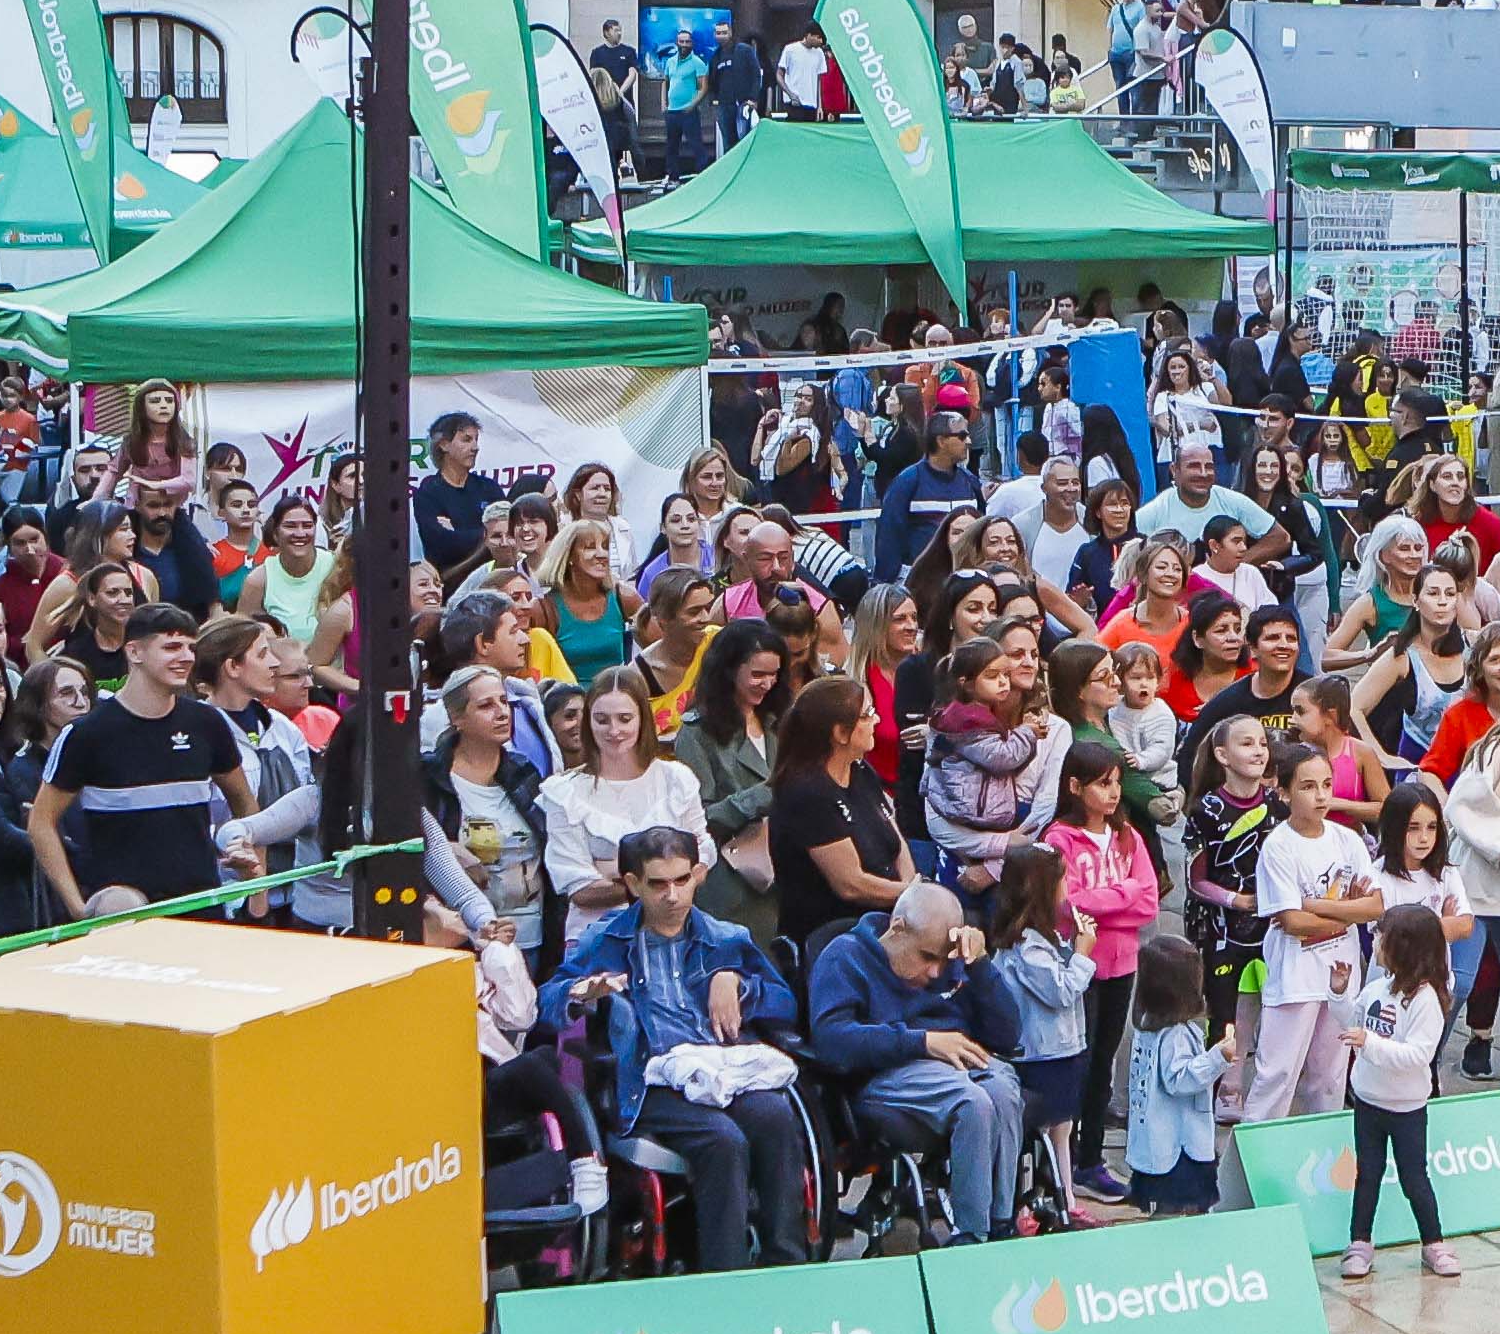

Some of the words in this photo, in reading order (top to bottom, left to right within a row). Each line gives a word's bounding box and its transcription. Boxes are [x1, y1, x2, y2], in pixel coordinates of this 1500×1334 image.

[320, 1140, 462, 1231] Iberdrola
[68, 1221, 156, 1259] MUJER
[1075, 1264, 1269, 1324] Iberdrola
